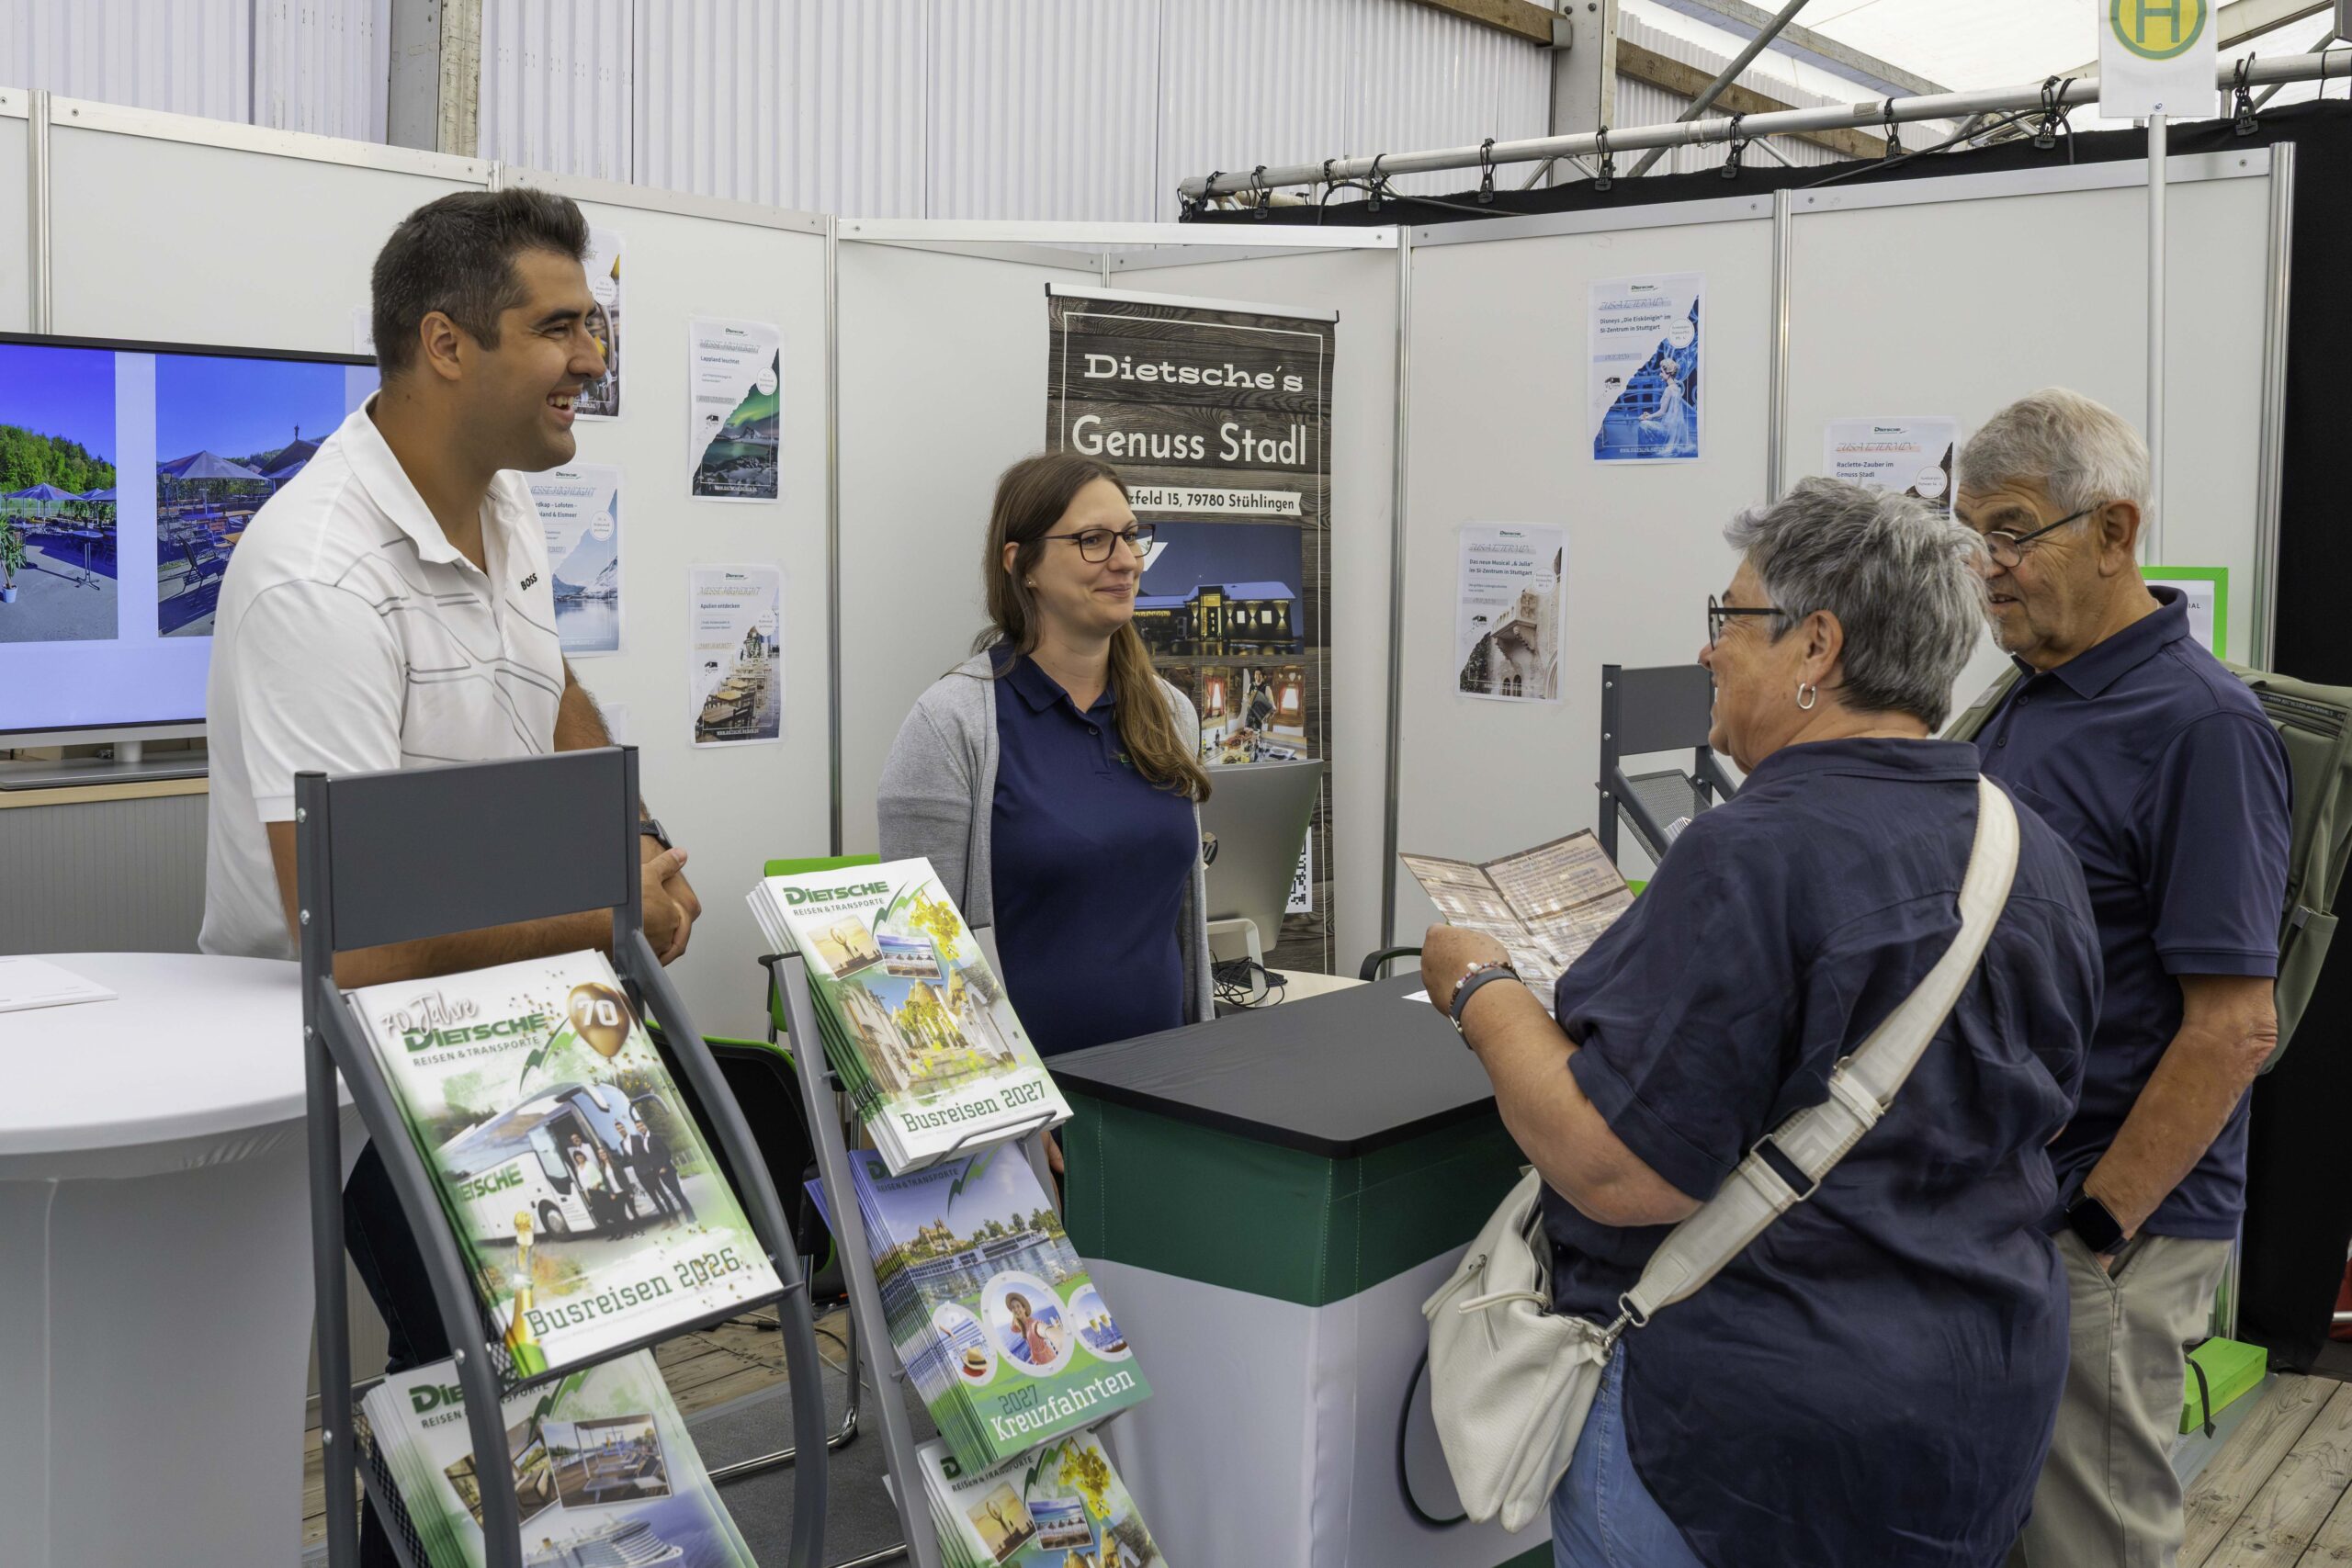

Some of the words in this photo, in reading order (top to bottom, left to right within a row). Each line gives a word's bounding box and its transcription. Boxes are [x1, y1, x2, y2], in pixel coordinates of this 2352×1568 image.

[2136, 0, 2180, 43] H
[1072, 415, 1205, 460] Genuss
[1220, 423, 1306, 465] Stadl
[531, 485, 596, 497] ESSE-HIGHLIGHT
[1129, 490, 1162, 505] zfeld
[1167, 492, 1182, 508] 15,
[1187, 493, 1225, 506] 79780
[1229, 493, 1295, 512] Stühlingen
[520, 573, 537, 592] BOSS
[793, 906, 823, 916] REISEN
[831, 897, 884, 912] TRANSPORTE
[381, 1009, 412, 1037] 70
[410, 990, 479, 1036] Jahre
[578, 998, 619, 1027] 70
[413, 1051, 456, 1066] REISEN
[458, 1050, 466, 1058] &
[467, 1036, 540, 1057] TRANSPORTE
[900, 1098, 1000, 1133] Busreisen
[1000, 1080, 1046, 1109] 2027
[876, 1182, 901, 1192] REISEN
[908, 1168, 959, 1188] TRANSPORTE
[525, 1276, 673, 1337] Busreisen
[673, 1247, 741, 1288] 2026
[989, 1370, 1136, 1441] Kreuzfahrten
[998, 1383, 1039, 1416] 2027
[421, 1410, 462, 1429] REISEN
[952, 1479, 978, 1493] REISEN
